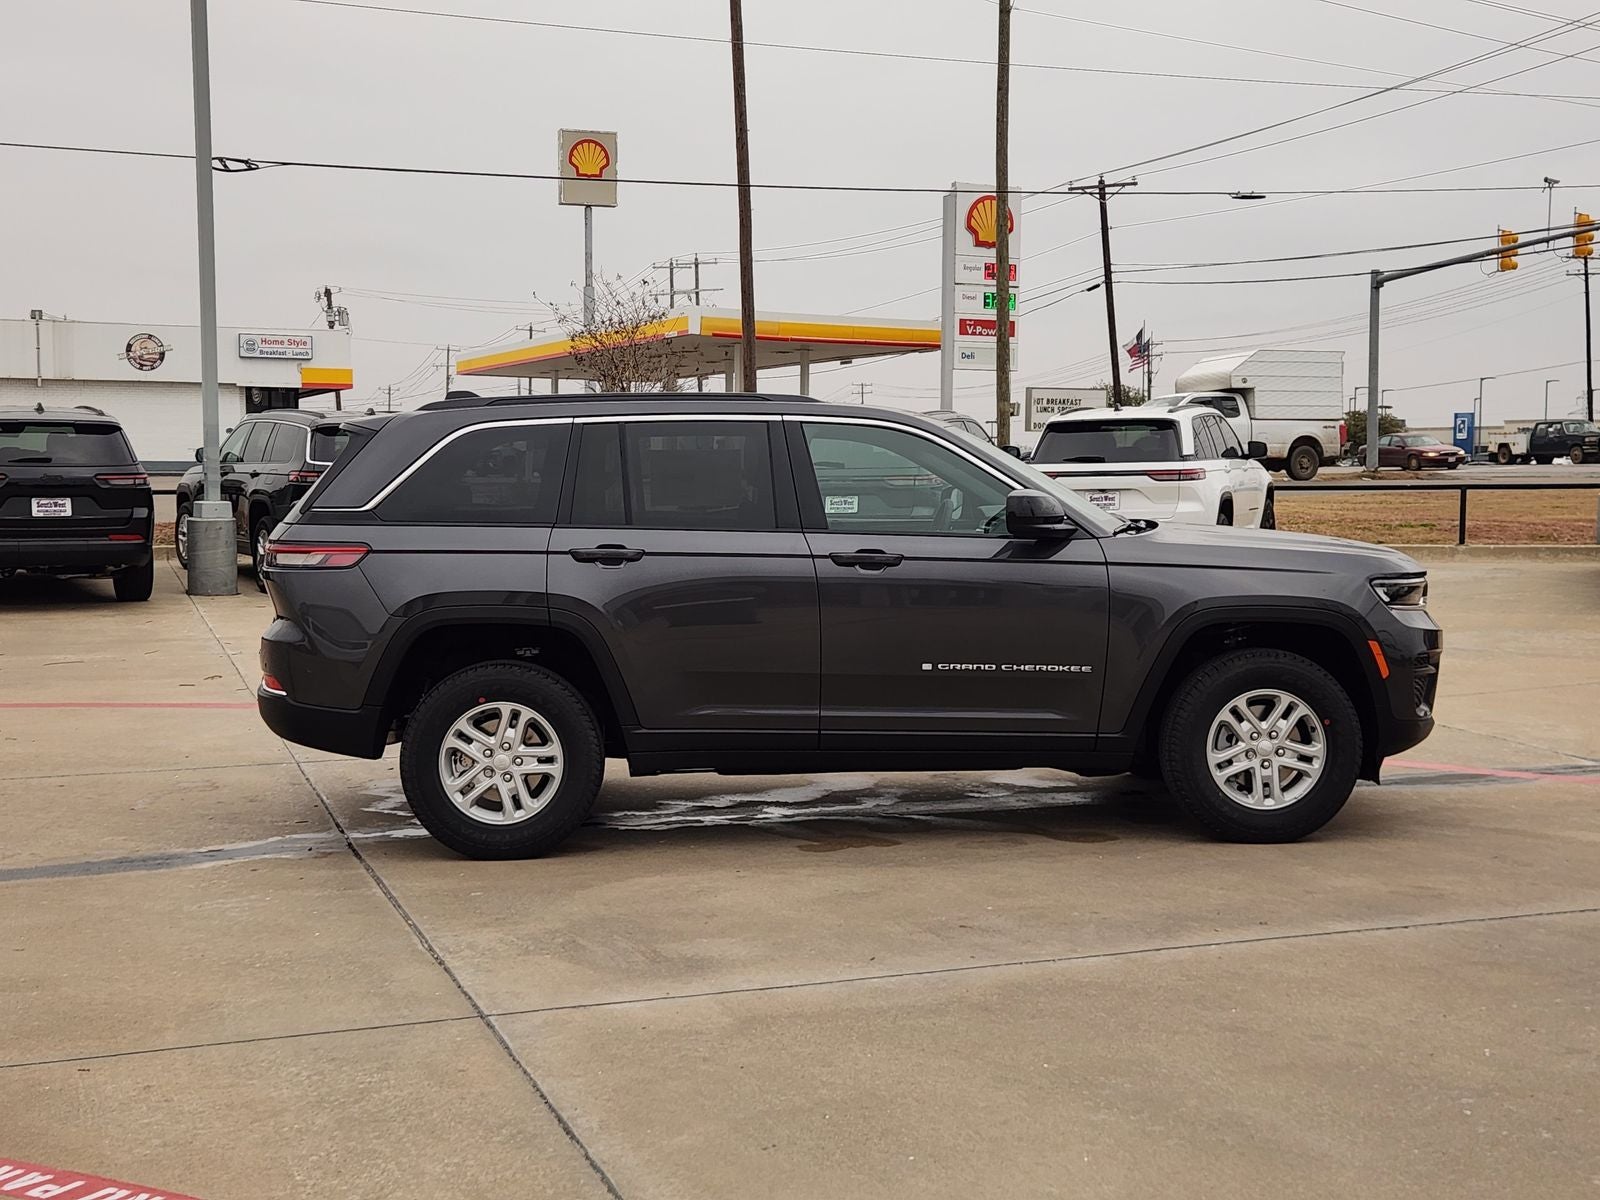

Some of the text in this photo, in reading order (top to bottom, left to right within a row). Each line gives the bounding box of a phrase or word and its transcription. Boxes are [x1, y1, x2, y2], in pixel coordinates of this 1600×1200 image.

[966, 325, 997, 335] V-Pow
[260, 337, 308, 347] Home Style
[961, 351, 976, 360] Deli
[1046, 398, 1081, 406] BREAKFAST
[937, 663, 1093, 673] GRAND CHEROKEE
